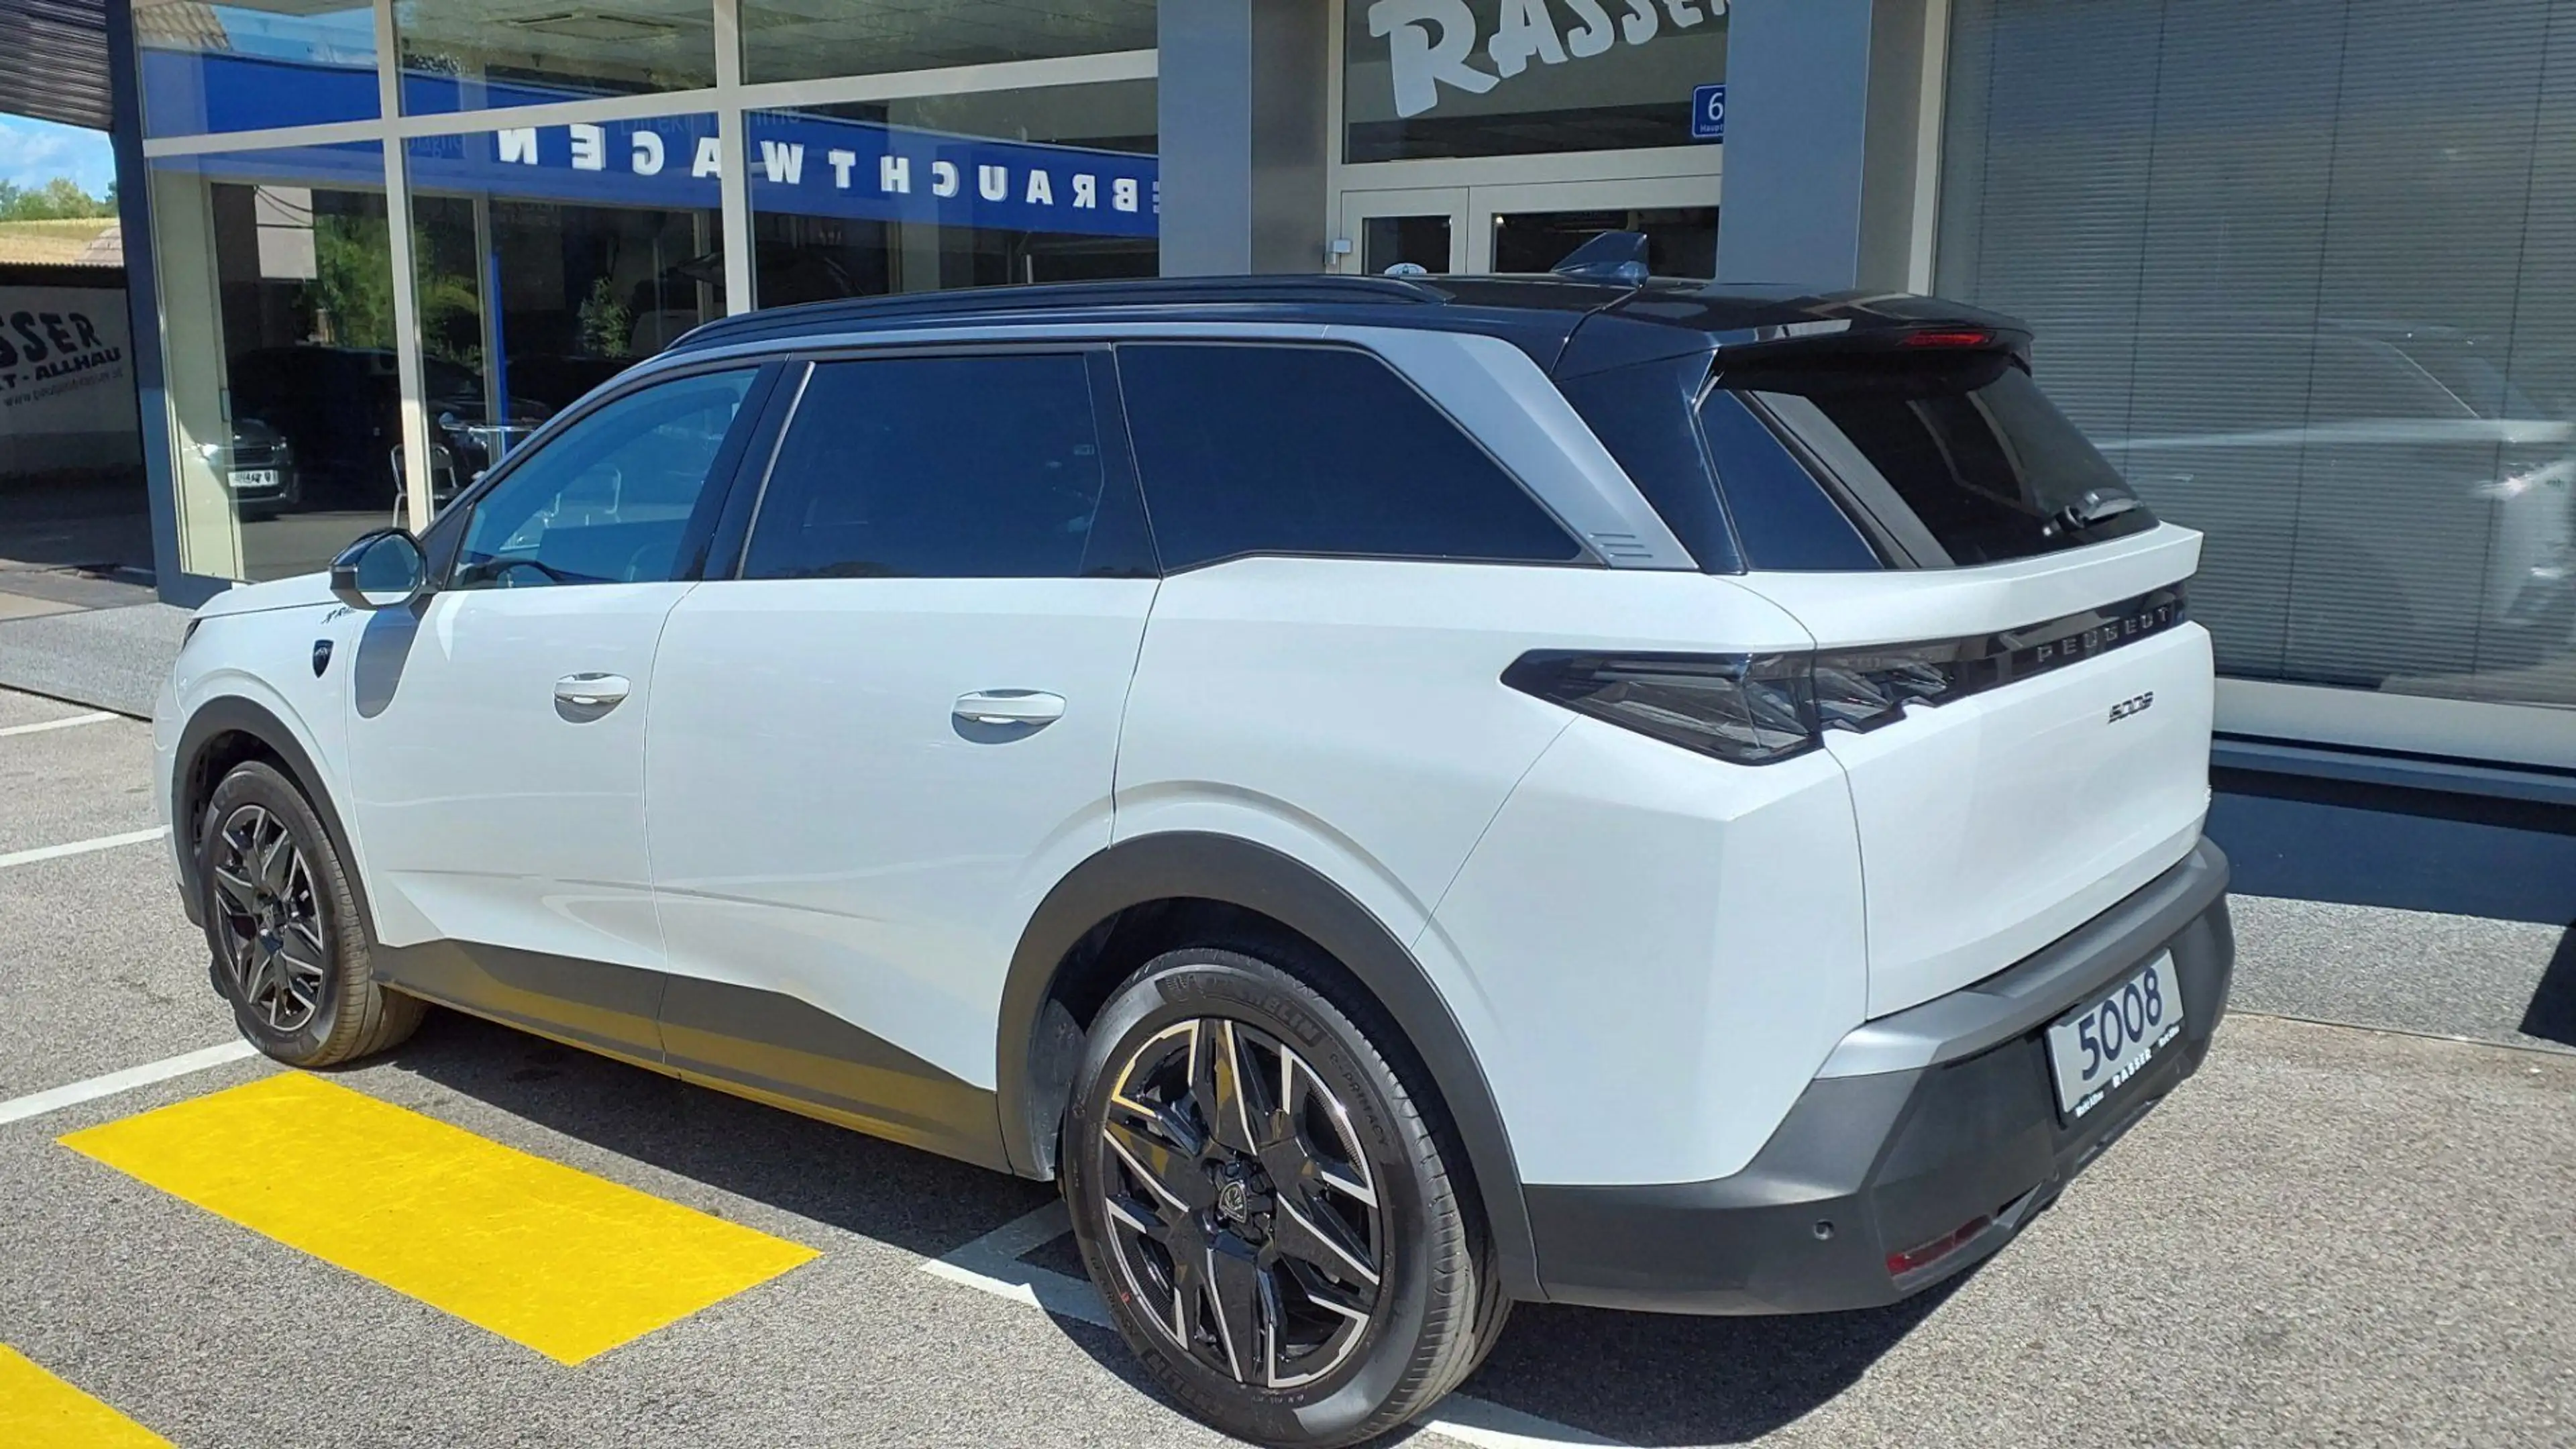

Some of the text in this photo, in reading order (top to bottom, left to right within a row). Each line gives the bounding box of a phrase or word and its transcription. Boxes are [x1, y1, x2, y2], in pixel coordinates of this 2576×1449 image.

[1368, 0, 1729, 118] RASSE
[1708, 92, 1724, 121] 6
[36, 346, 122, 382] ALLHAU
[2037, 606, 2169, 663] PEUGEOT
[2078, 967, 2163, 1081] 5008
